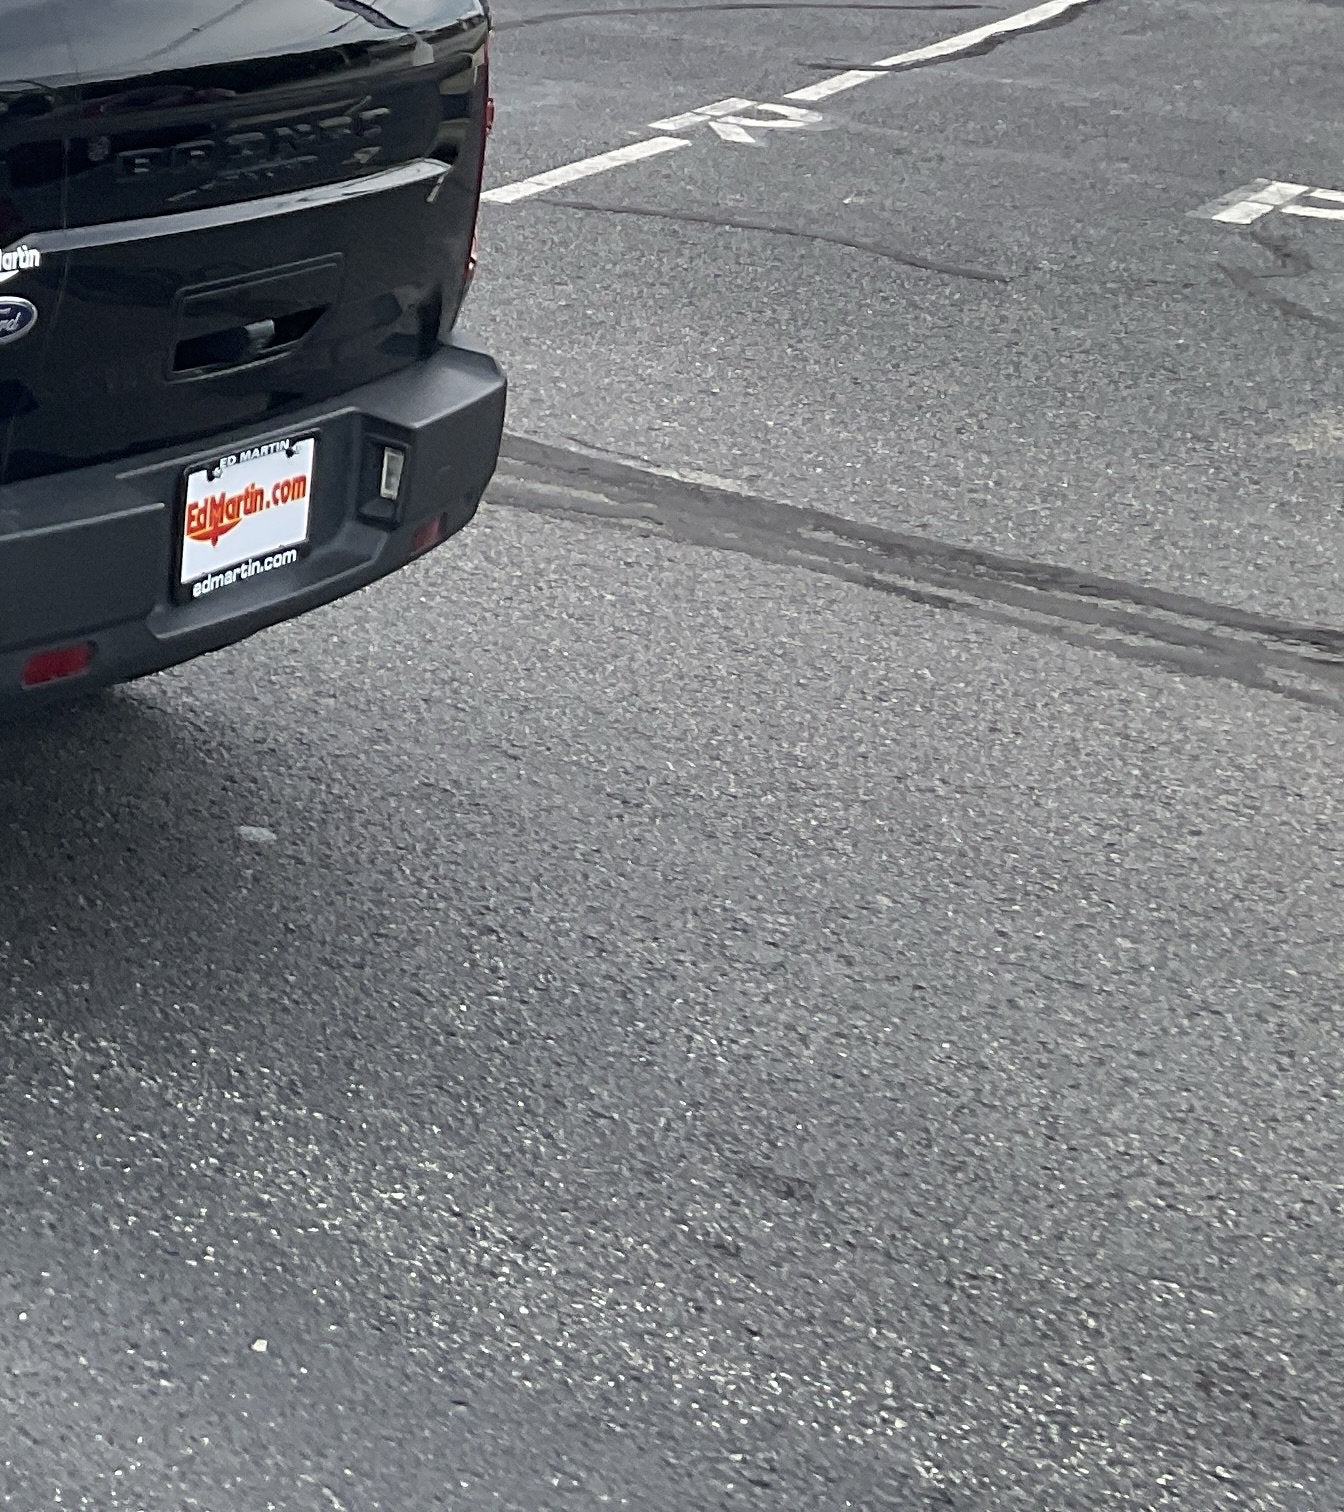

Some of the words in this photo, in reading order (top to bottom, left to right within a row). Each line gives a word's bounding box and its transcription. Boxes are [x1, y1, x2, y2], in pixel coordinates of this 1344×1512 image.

[219, 455, 237, 469] ED
[240, 438, 290, 463] MARTIN
[186, 474, 307, 537] EdMartin.com
[192, 548, 297, 598] edmartin.com
